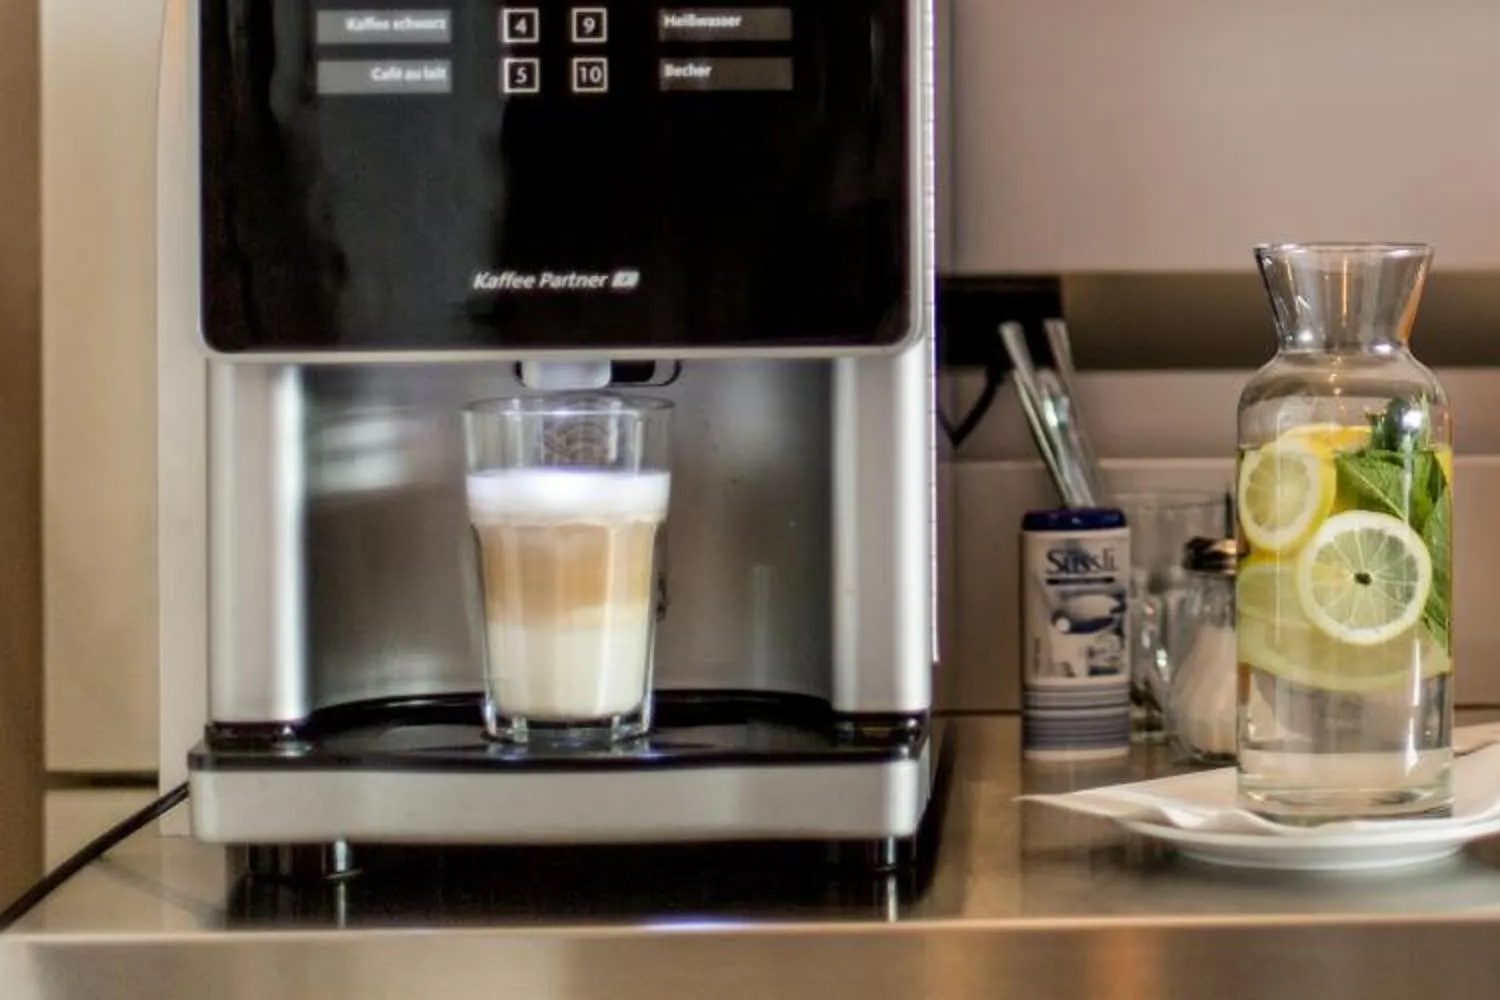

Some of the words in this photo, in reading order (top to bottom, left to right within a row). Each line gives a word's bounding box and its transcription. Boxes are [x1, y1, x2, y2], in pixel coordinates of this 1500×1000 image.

[514, 18, 528, 35] 4
[583, 17, 595, 34] 9
[516, 67, 528, 83] 5
[580, 66, 602, 83] 10
[664, 63, 712, 78] Becher
[473, 271, 536, 290] Kaffee
[540, 271, 608, 289] Partner
